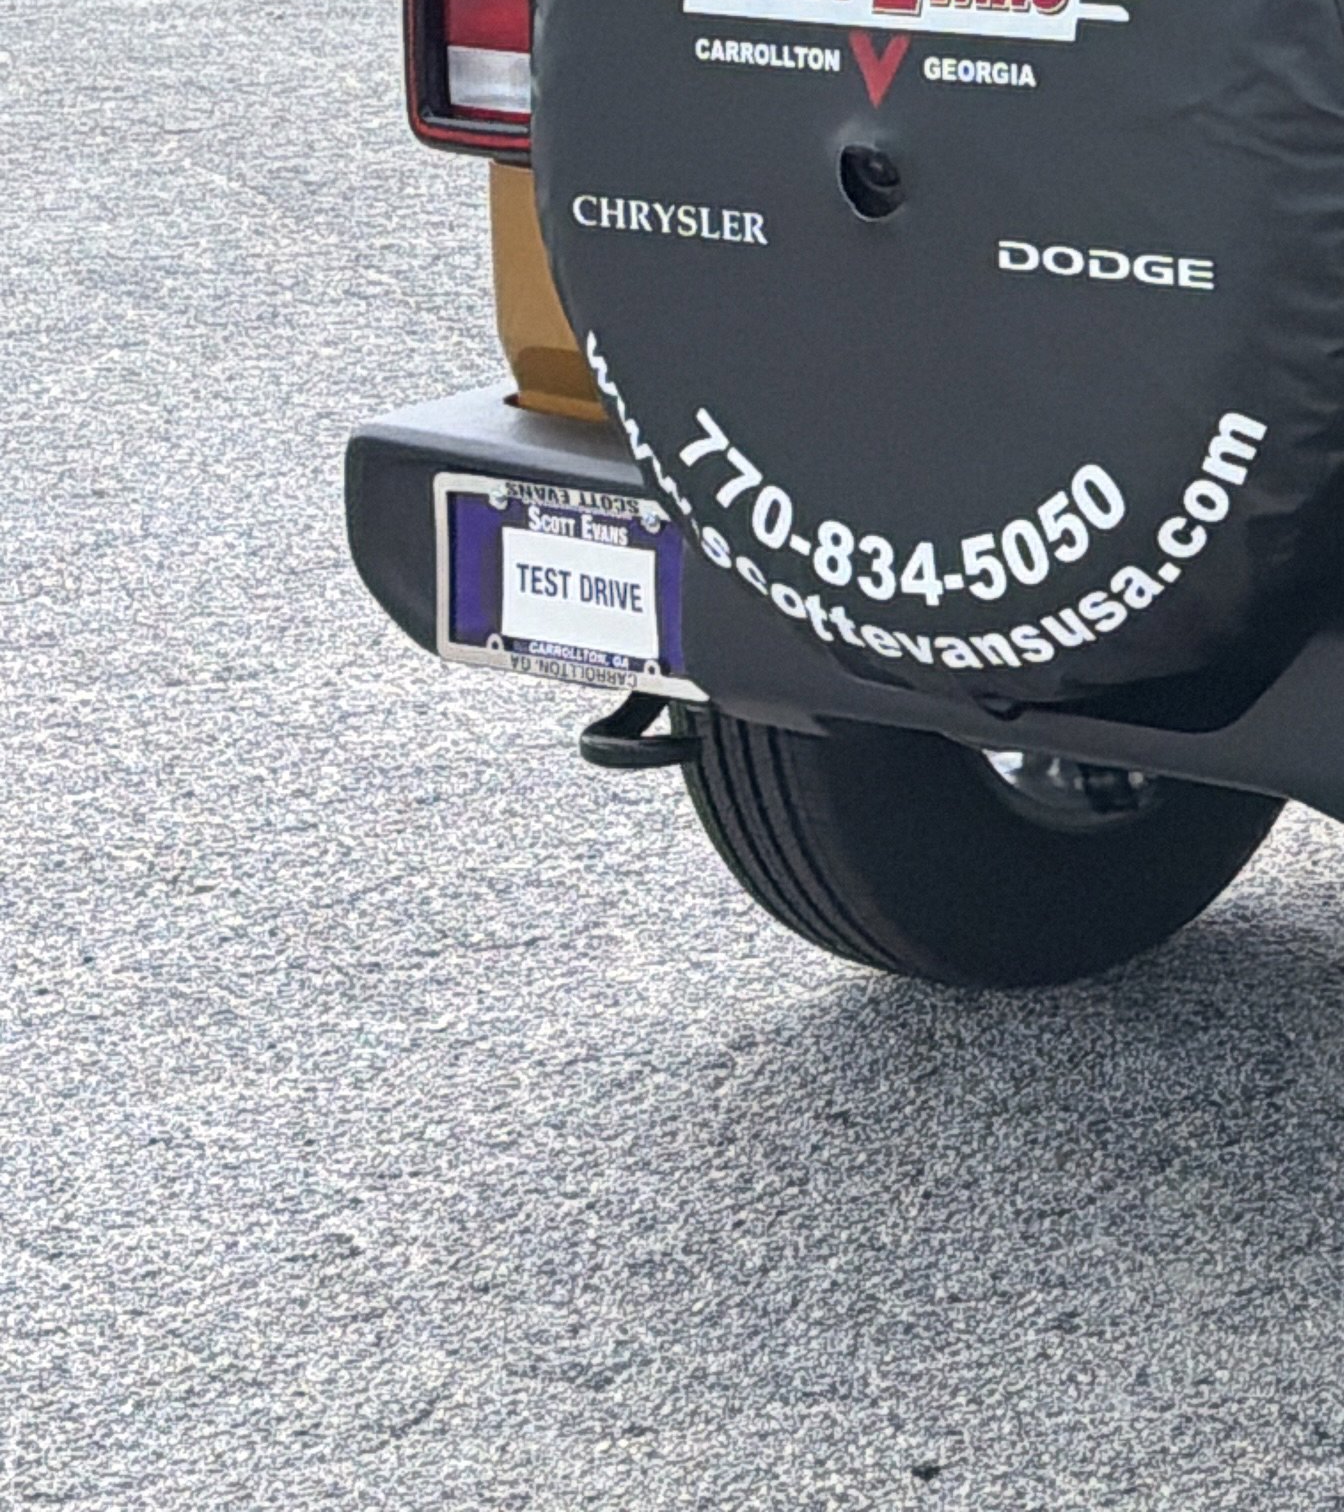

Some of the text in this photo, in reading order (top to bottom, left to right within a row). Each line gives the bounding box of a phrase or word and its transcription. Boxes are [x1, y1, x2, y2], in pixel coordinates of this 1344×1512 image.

[695, 37, 1037, 88] CARROLLTON GEORGIA
[572, 194, 768, 246] CHRYSLER
[997, 240, 1216, 291] DODGE
[505, 481, 639, 514] SCOTT EVANS
[678, 407, 1126, 607] 770-834-5050
[516, 562, 643, 613] TEST DRIVE
[510, 653, 532, 672] GA
